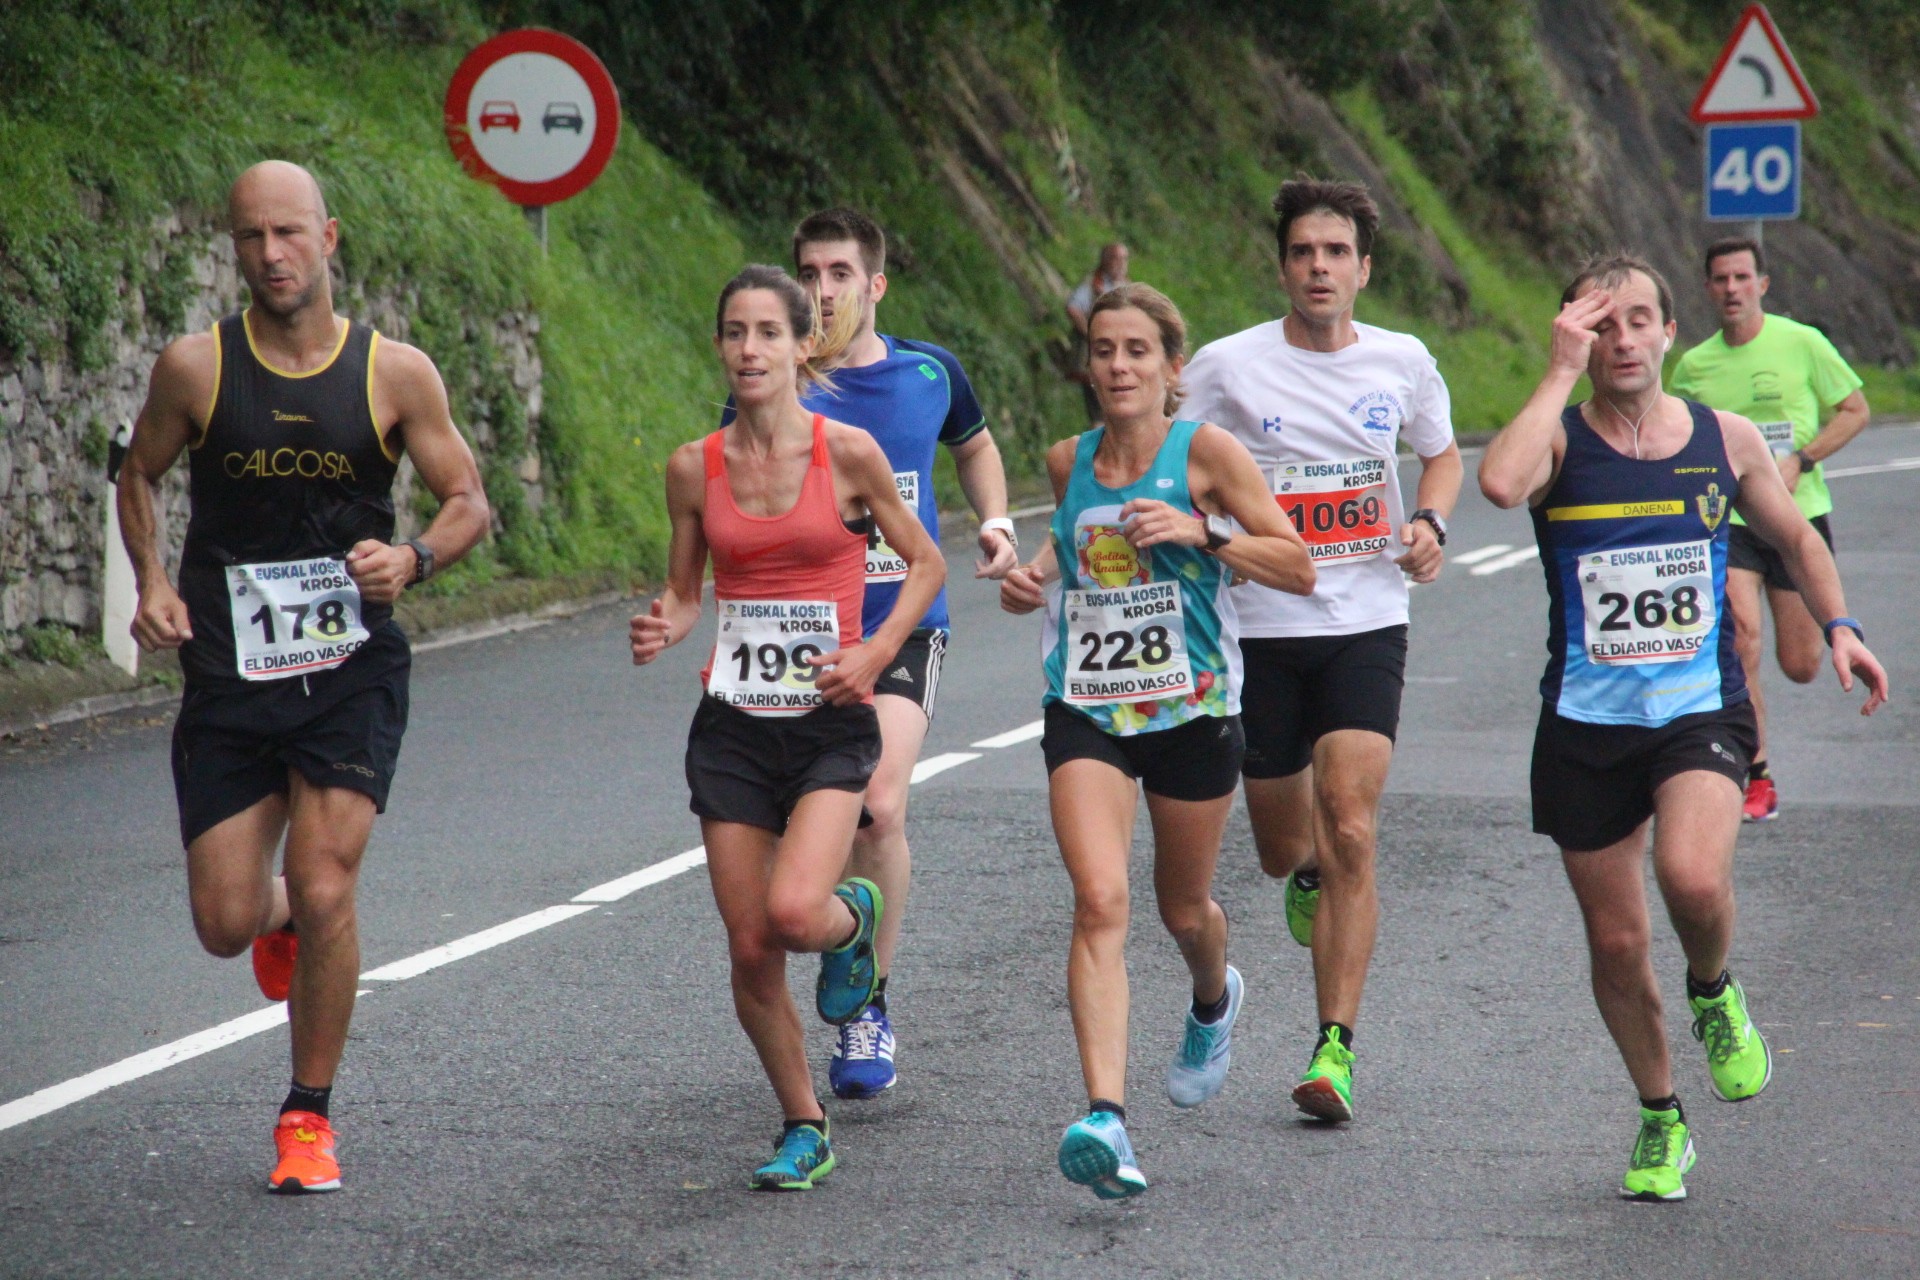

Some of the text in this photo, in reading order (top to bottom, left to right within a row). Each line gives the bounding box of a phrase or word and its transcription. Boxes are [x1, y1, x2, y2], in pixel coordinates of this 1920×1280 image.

[1712, 145, 1792, 195] 40
[224, 448, 356, 481] CALCOSA
[1304, 460, 1385, 477] EUSKAL KOSTA
[896, 475, 914, 488] STA
[1343, 471, 1382, 488] KROSA
[1287, 496, 1380, 533] 1069
[1623, 503, 1674, 515] DANENA
[1349, 538, 1387, 553] VASCO
[1610, 545, 1706, 566] EUSKAL KOSTA
[255, 565, 307, 580] EUSKAL
[878, 559, 907, 572] VASC
[1656, 562, 1707, 577] KROSA
[300, 575, 352, 592] KROSA
[1086, 585, 1175, 607] EUSKAL KOSTA
[741, 604, 832, 618] EUSKAL KOSTA
[1123, 599, 1176, 619] KROSA
[1598, 585, 1702, 631] 268
[250, 600, 348, 644] 178
[780, 620, 833, 633] KROSA
[1079, 625, 1173, 671] 228
[1591, 635, 1704, 656] EL DIARIO VASC
[244, 658, 262, 671] EL
[264, 650, 315, 669] DIARIO
[731, 642, 823, 682] 199
[1070, 671, 1187, 695] EL DIARIO VASCO
[714, 691, 822, 706] EL DIARIO VASC
